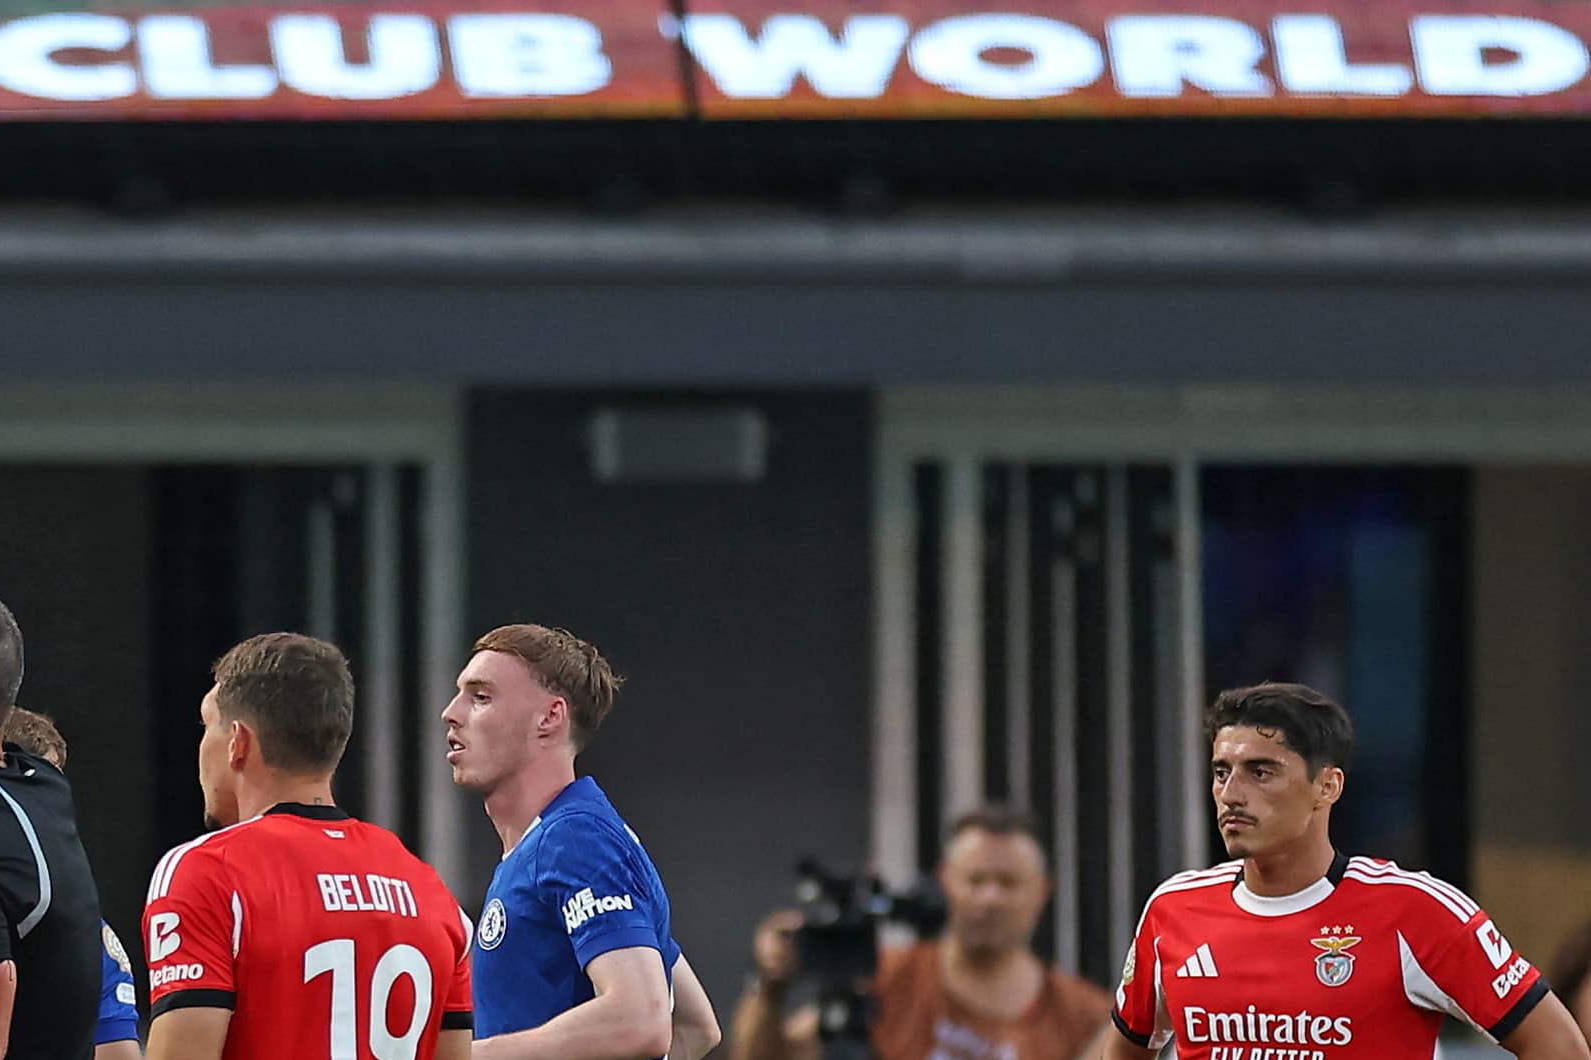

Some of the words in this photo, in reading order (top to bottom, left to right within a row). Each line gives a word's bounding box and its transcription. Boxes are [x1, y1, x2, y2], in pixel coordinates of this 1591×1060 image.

[657, 11, 1590, 99] WORLD
[316, 873, 418, 918] BELOTTI
[562, 887, 595, 914] LIVE
[565, 894, 634, 935] NATION
[1183, 1004, 1353, 1046] Emirates
